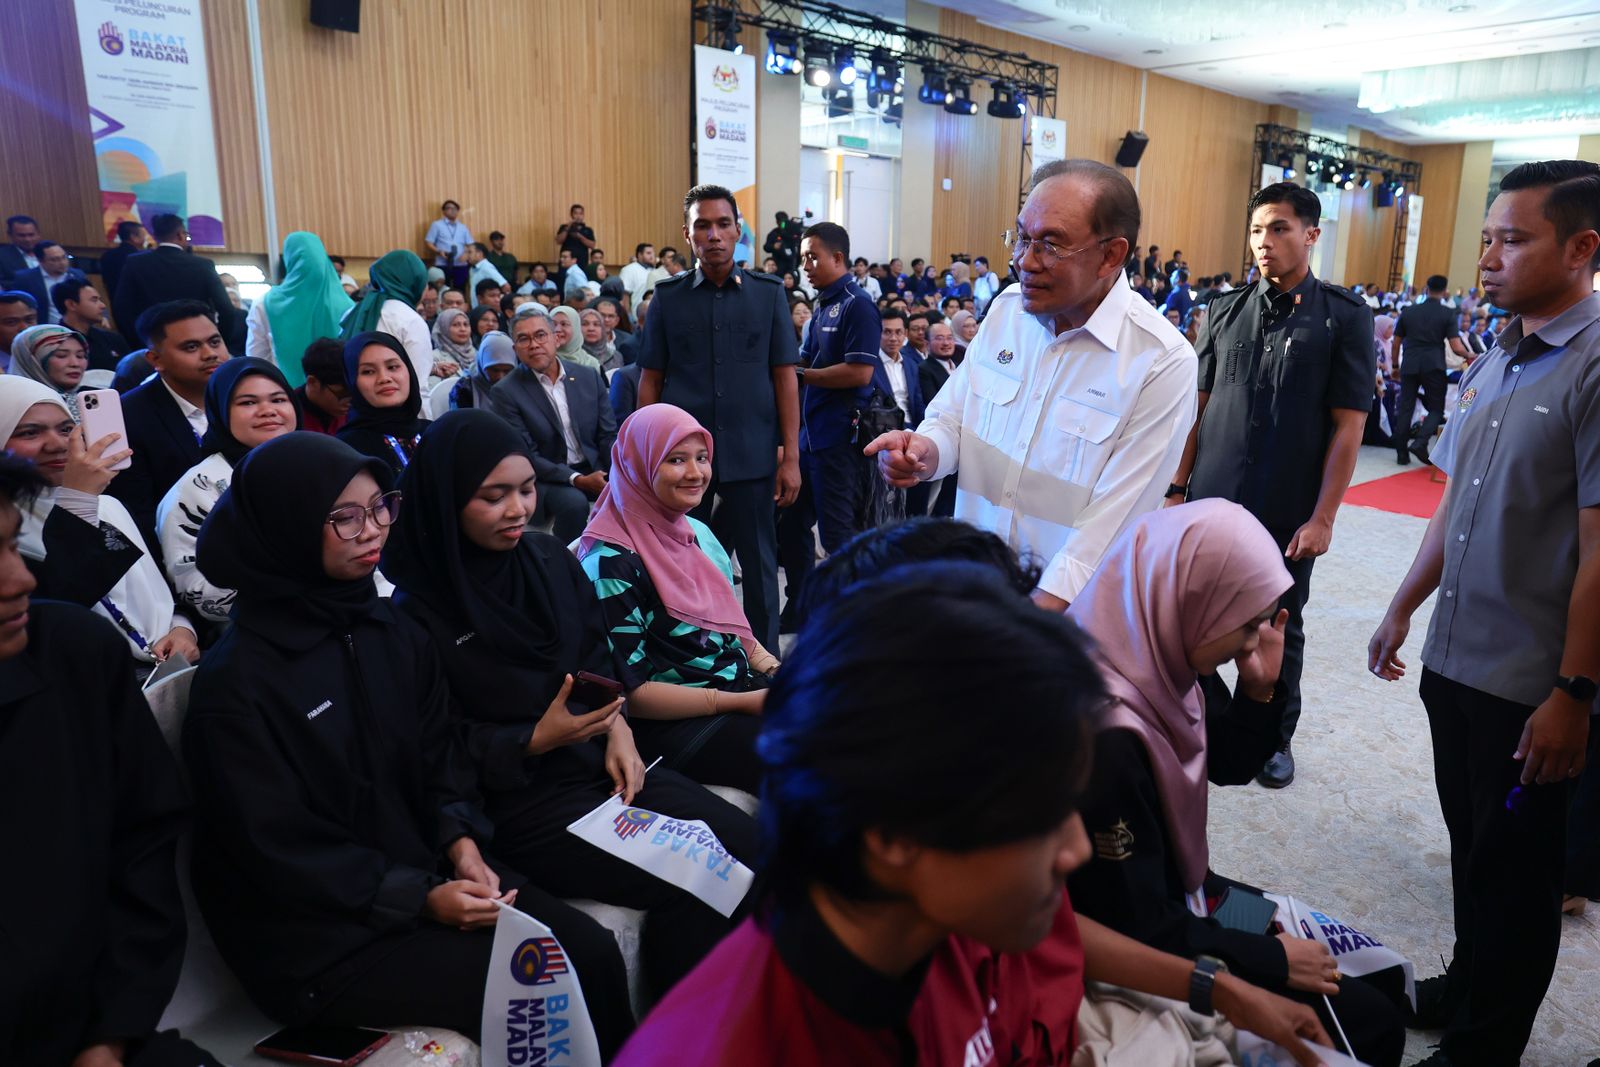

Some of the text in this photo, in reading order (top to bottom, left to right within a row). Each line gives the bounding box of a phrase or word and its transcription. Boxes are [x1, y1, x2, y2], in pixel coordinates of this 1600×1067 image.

[114, 5, 165, 20] PROGRAM
[128, 28, 186, 45] BAKAT
[129, 39, 188, 55] MALAYSIA
[130, 48, 189, 65] MADANI
[507, 999, 528, 1067] MAD
[547, 994, 570, 1067] BAK
